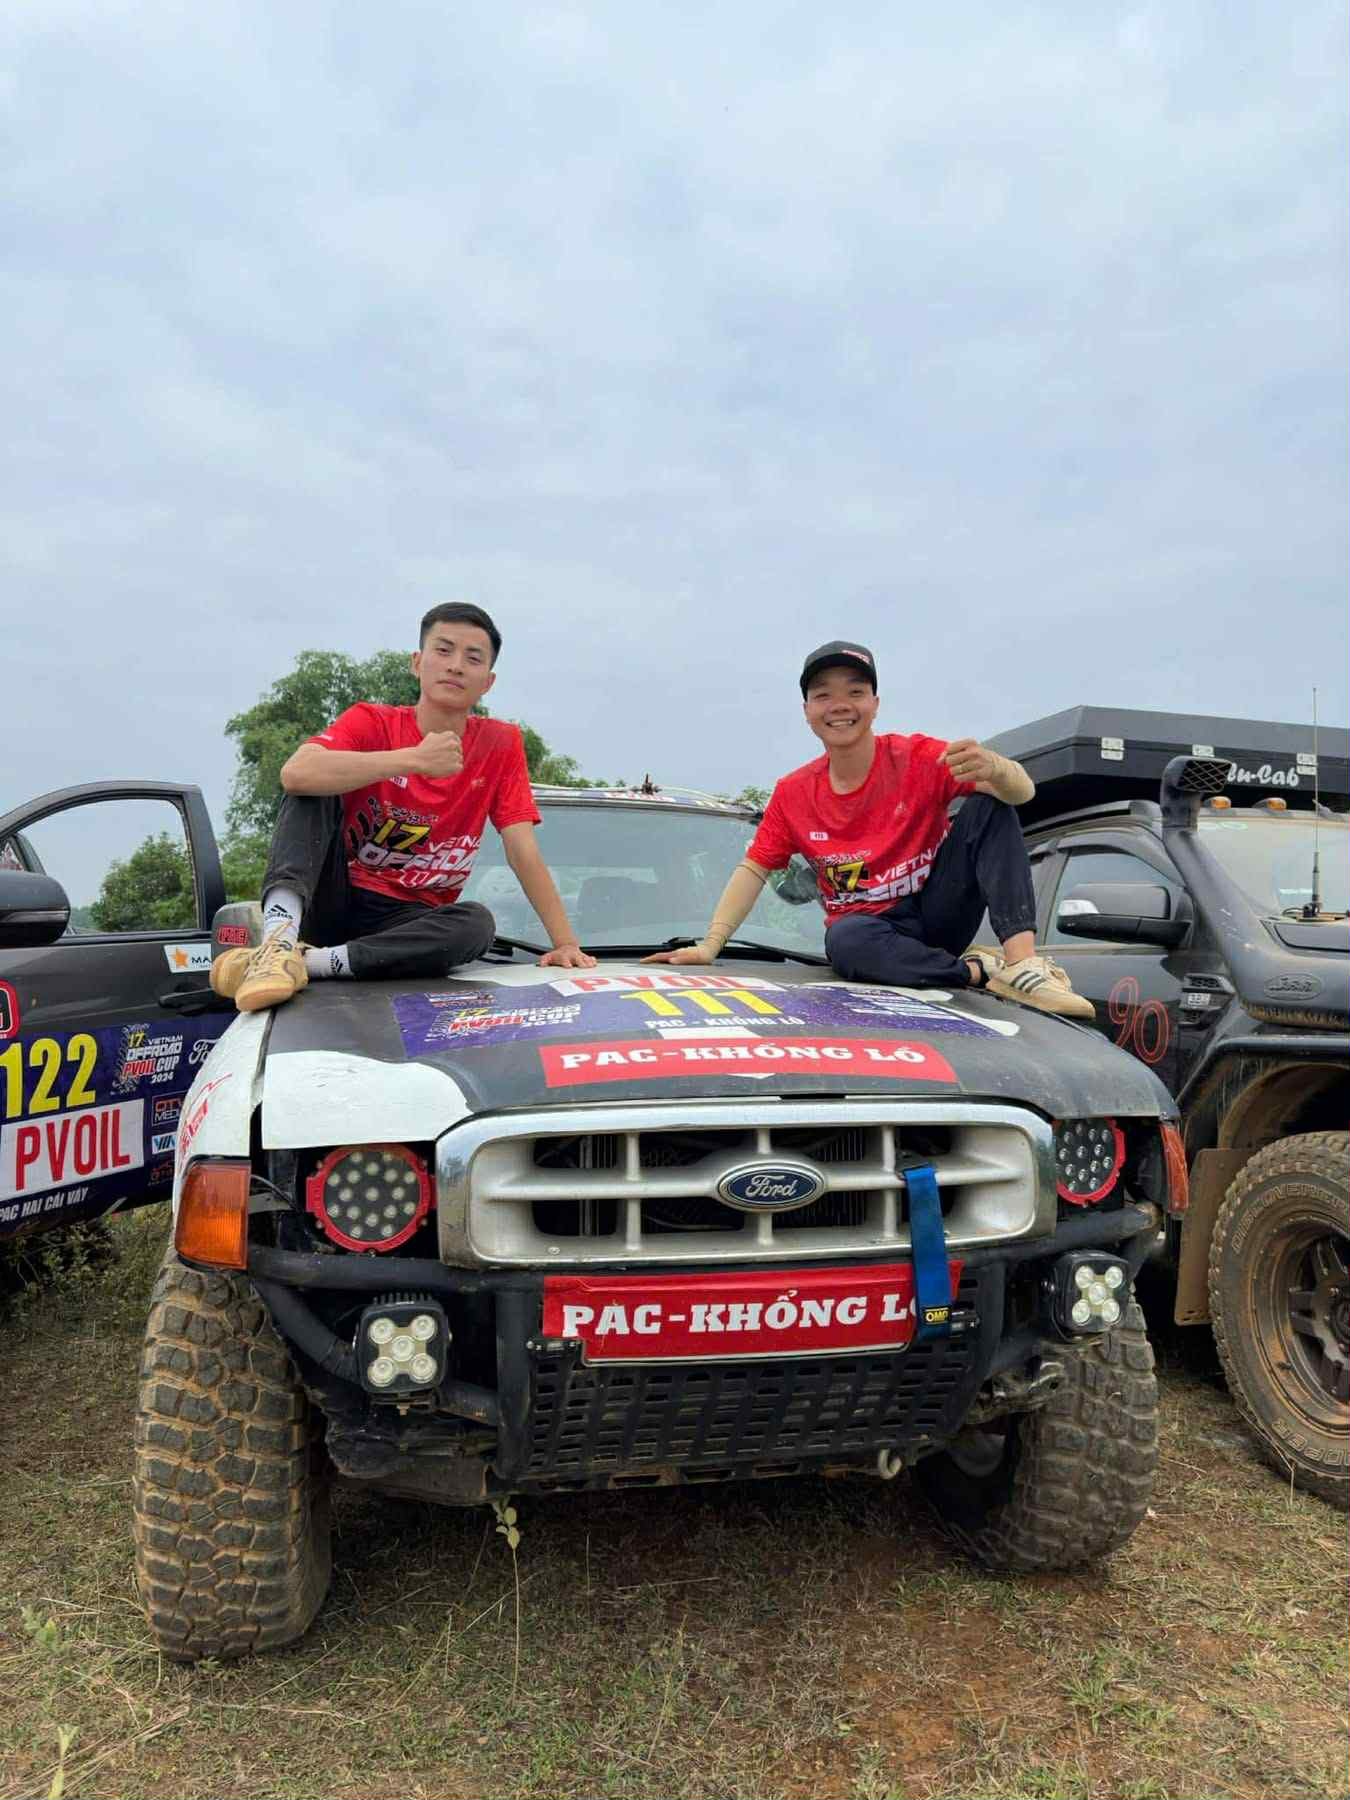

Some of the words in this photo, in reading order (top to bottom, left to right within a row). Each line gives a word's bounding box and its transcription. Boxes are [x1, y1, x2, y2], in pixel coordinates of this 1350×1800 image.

[568, 974, 765, 992] PVOIL
[619, 990, 783, 1016] 111
[1109, 976, 1170, 1064] 90
[127, 1041, 183, 1061] OFFROAD
[147, 1033, 184, 1046] VIETNAM
[0, 1032, 98, 1118] 122
[156, 1055, 180, 1073] CUP
[16, 1108, 131, 1191] PVOIL
[744, 1173, 799, 1198] Ford
[881, 1292, 915, 1322] L
